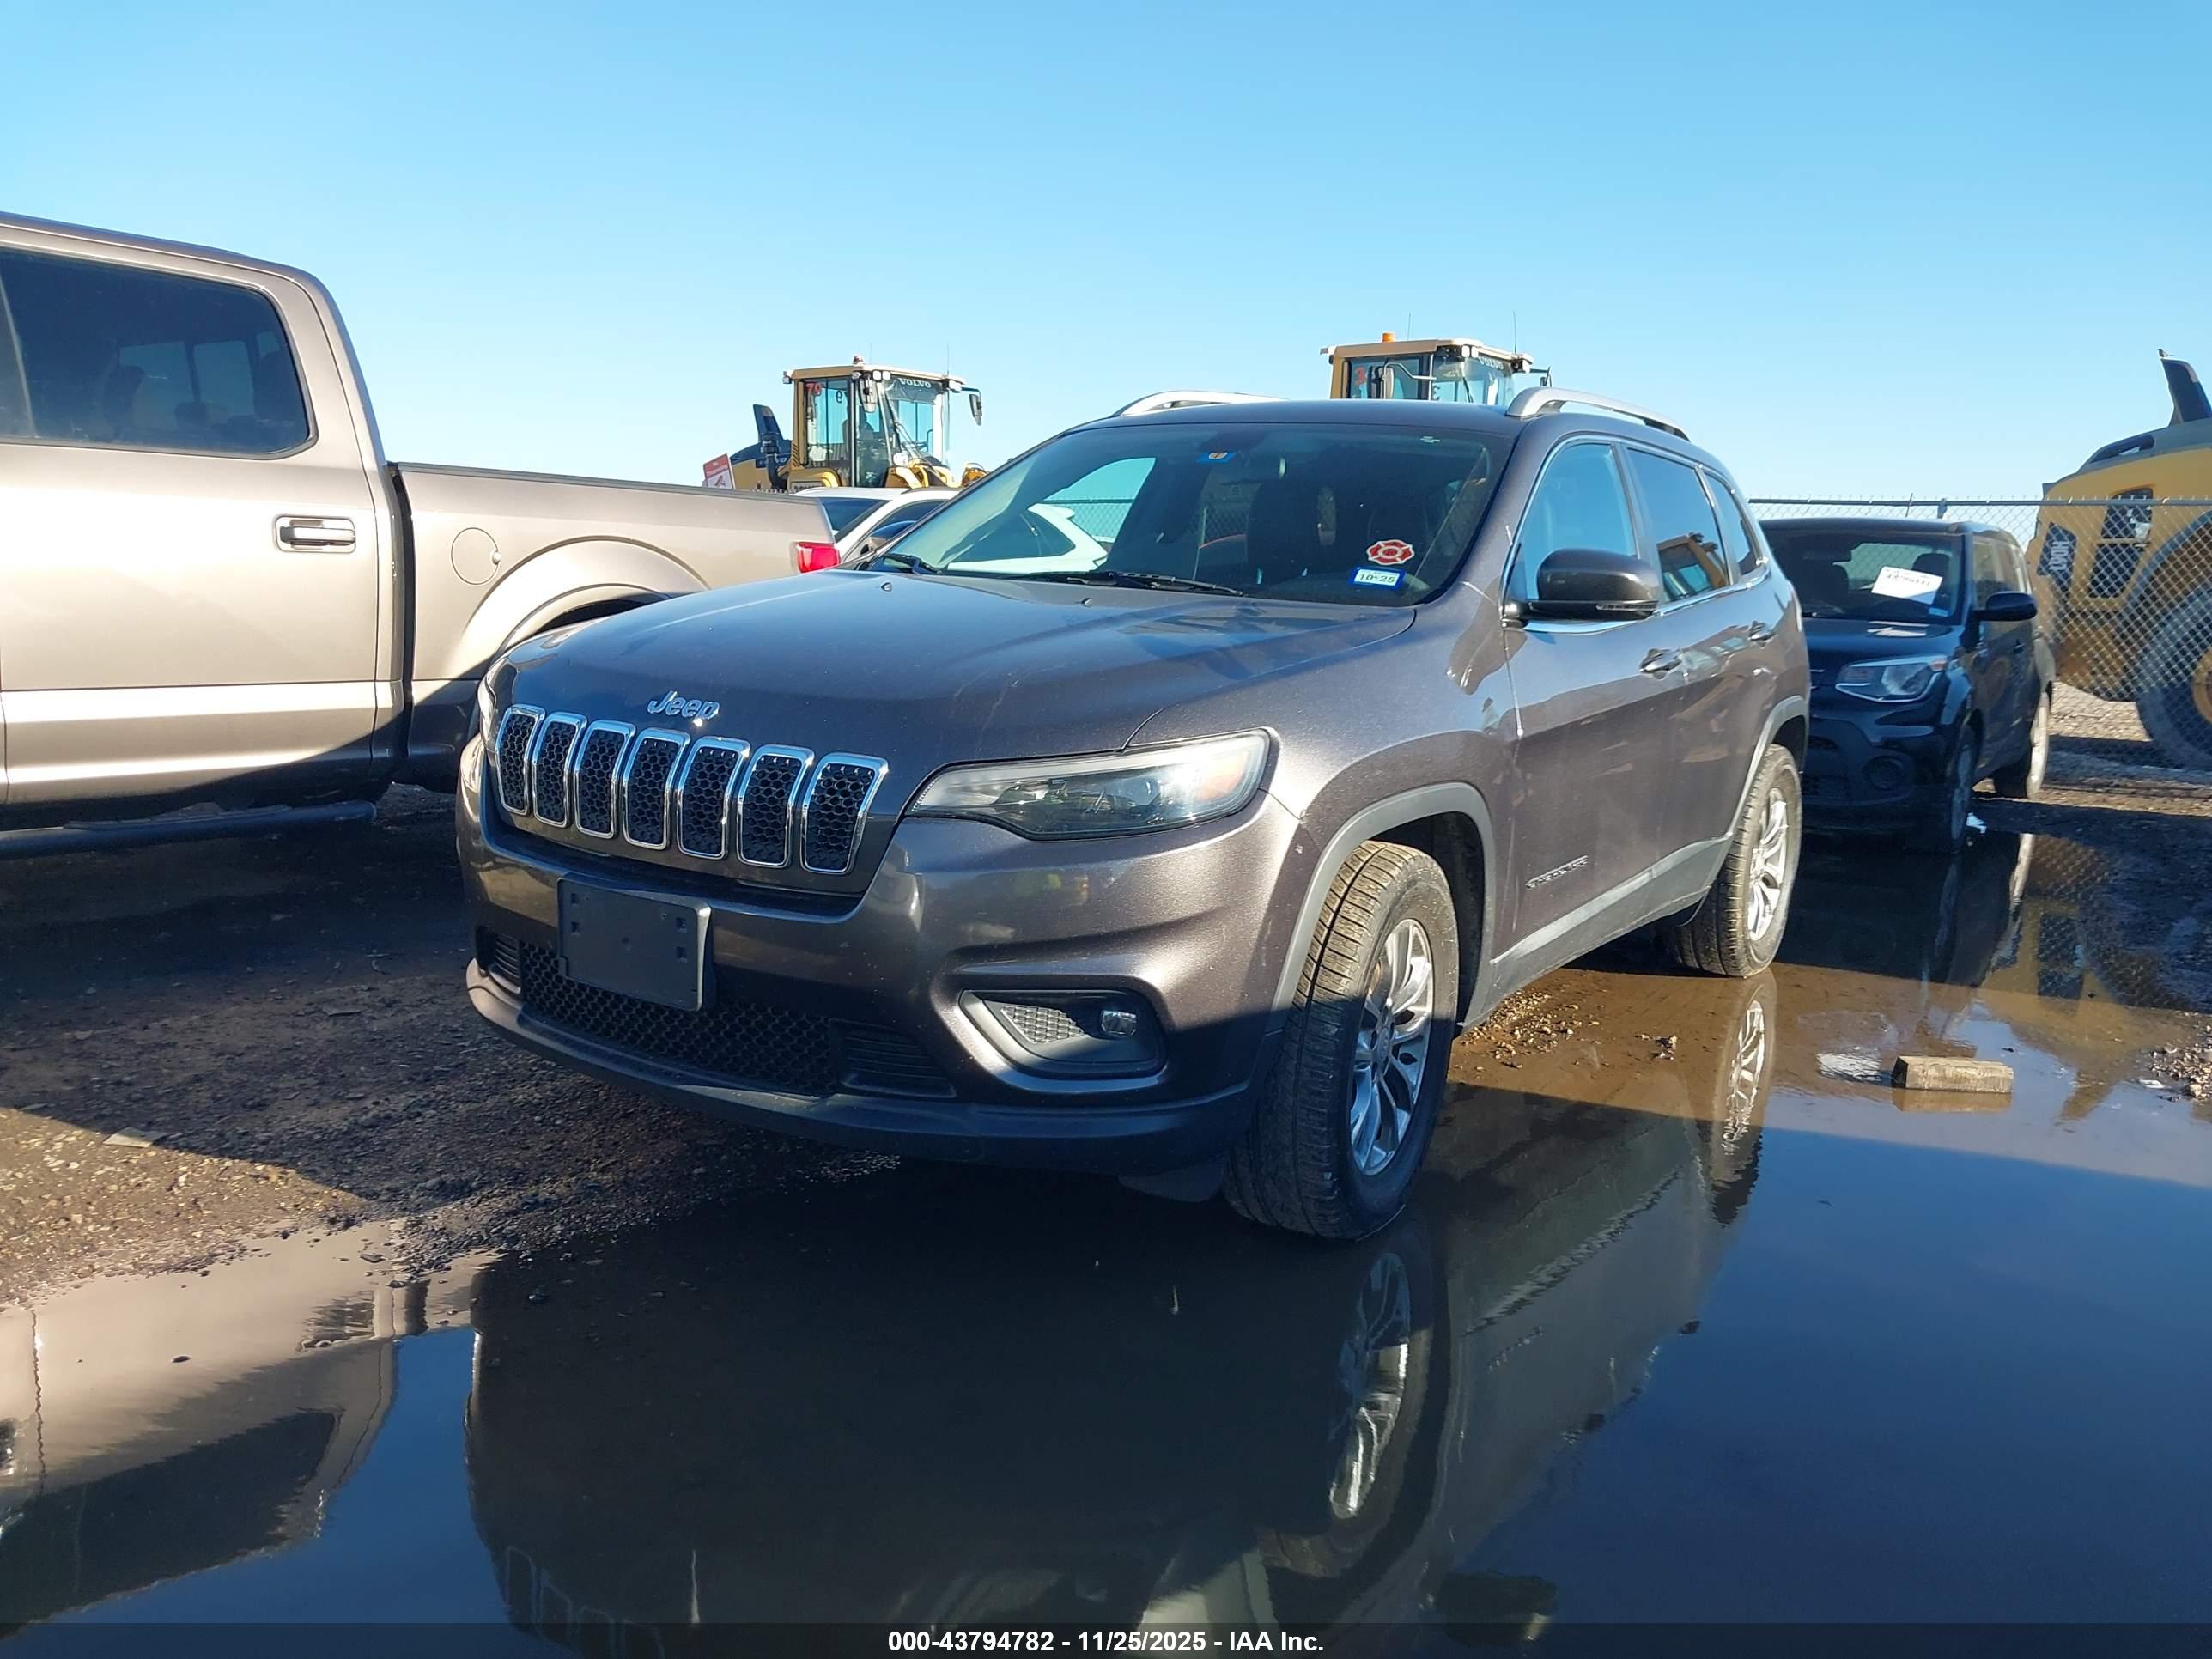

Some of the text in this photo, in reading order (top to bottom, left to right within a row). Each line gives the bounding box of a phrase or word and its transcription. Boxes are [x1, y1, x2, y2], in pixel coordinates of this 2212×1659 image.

[897, 378, 932, 388] VOLVO
[2049, 540, 2069, 571] L90H
[647, 690, 720, 724] Jeep
